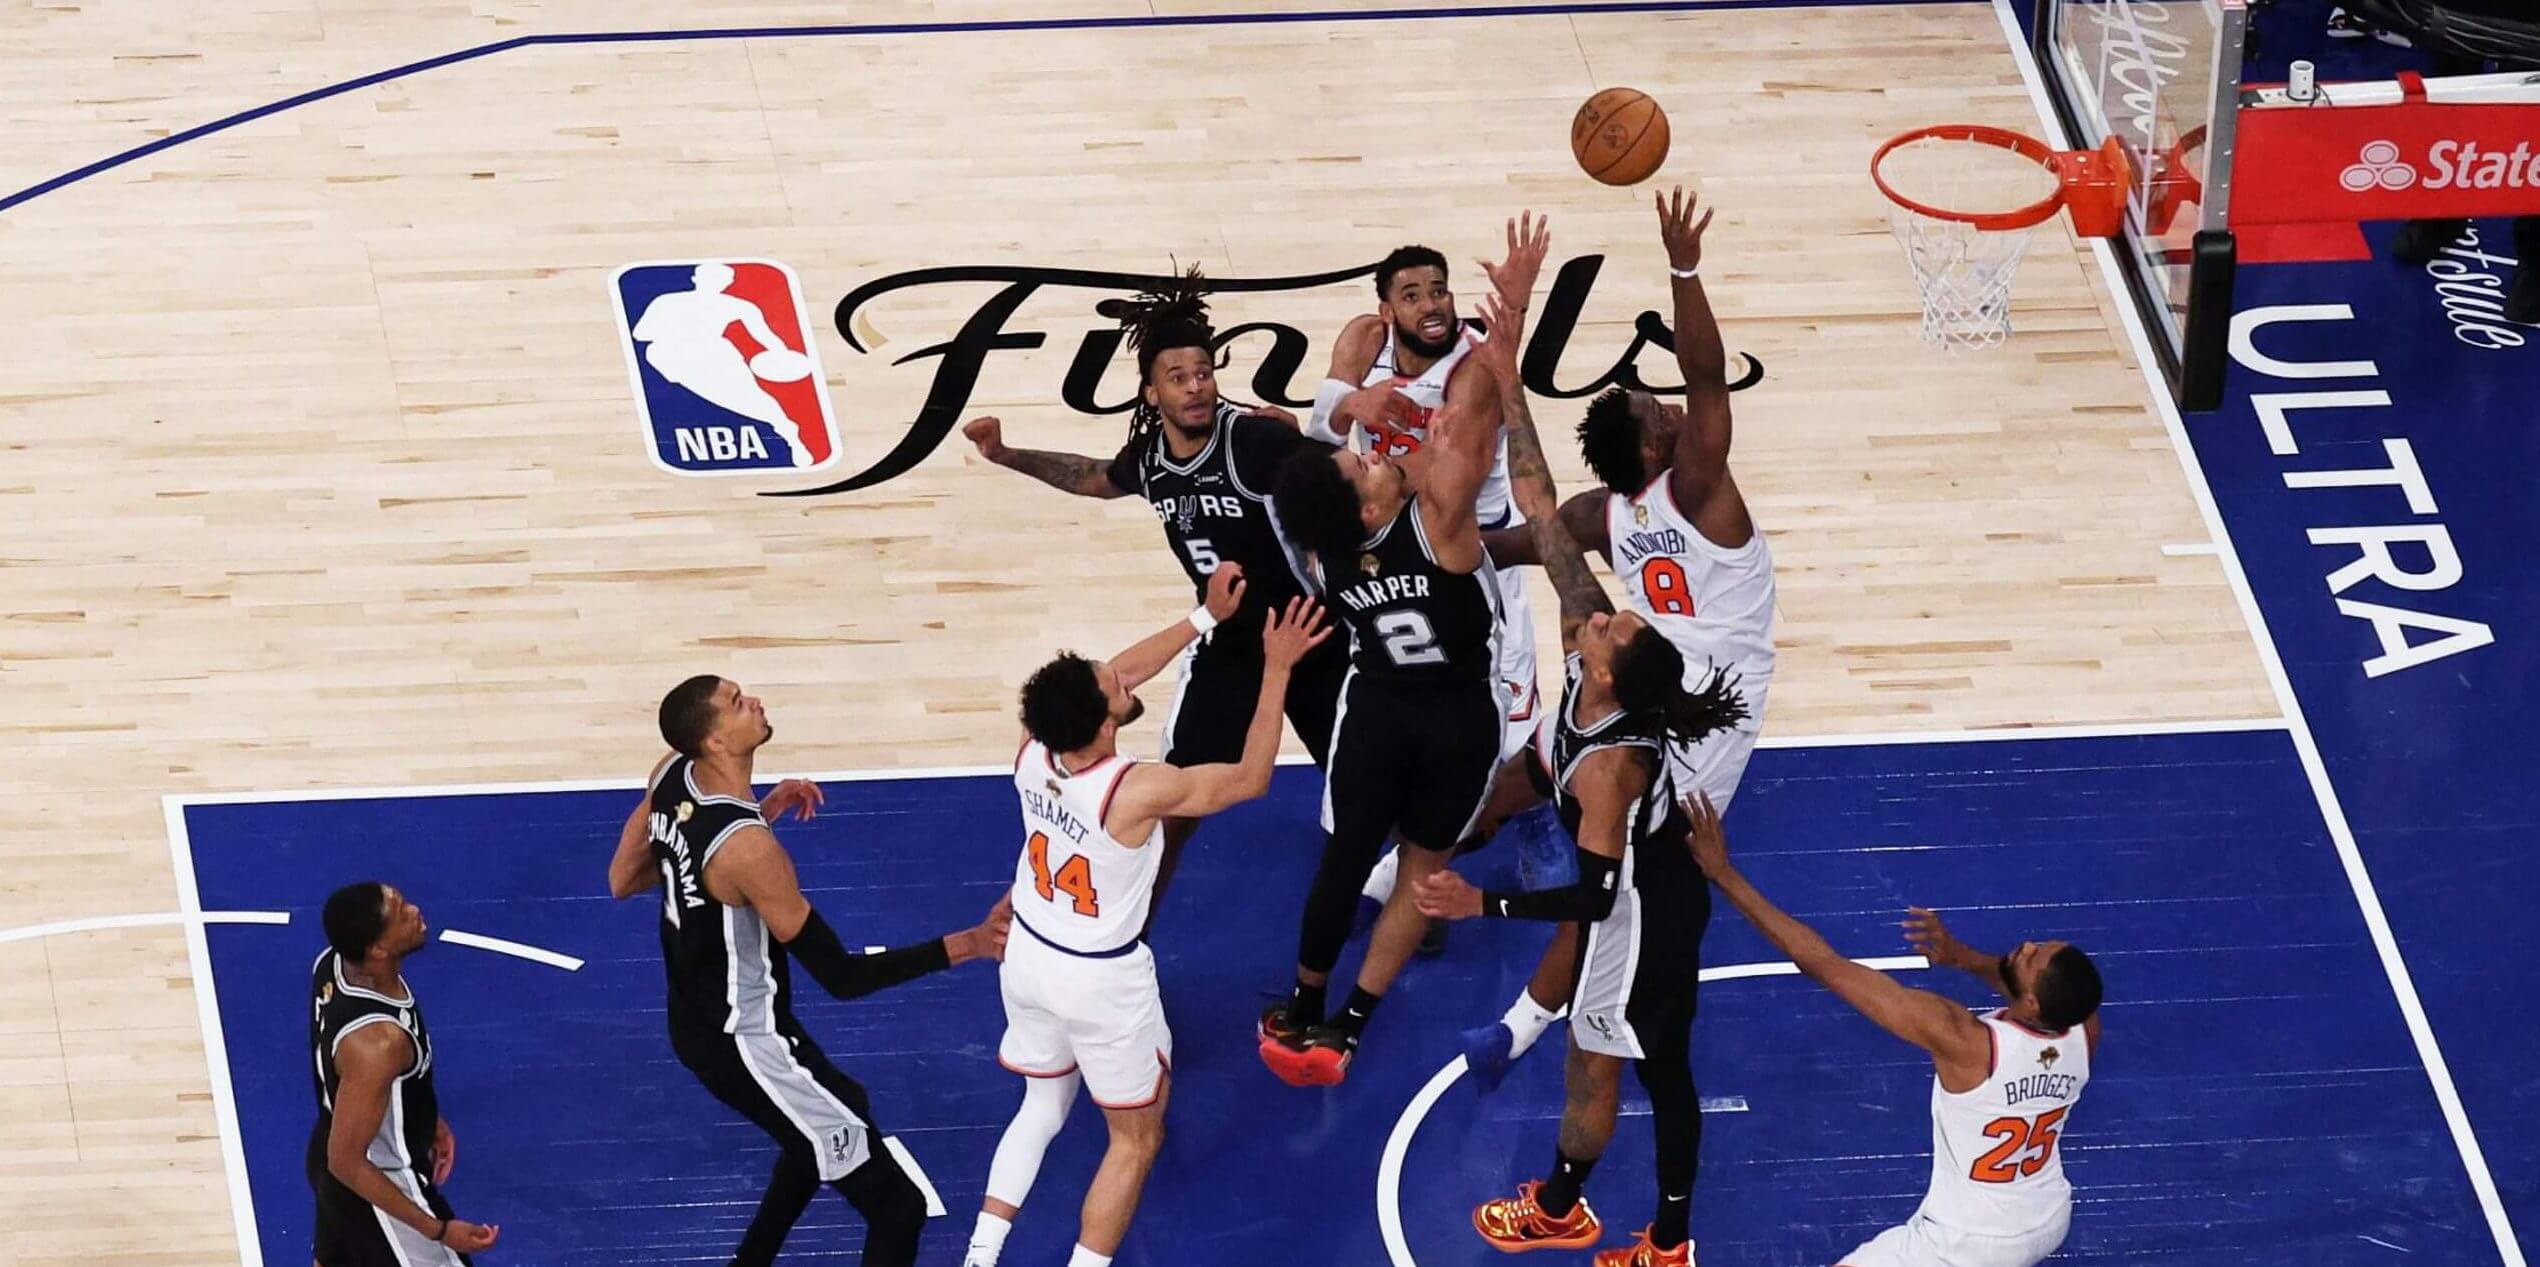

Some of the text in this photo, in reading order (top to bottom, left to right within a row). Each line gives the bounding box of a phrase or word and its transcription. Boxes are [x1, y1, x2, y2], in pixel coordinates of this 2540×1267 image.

[2422, 139, 2540, 189] State
[673, 425, 770, 464] NBA
[2228, 304, 2495, 679] ULTRA
[1185, 539, 1221, 574] 5
[1339, 574, 1431, 611] HARPER
[1641, 556, 1696, 618] 8
[1373, 608, 1450, 668] 2
[1024, 789, 1089, 845] SHAMET
[1027, 830, 1099, 918] 44
[2004, 1073, 2077, 1106] BRIDGES
[1968, 1104, 2071, 1183] 25
